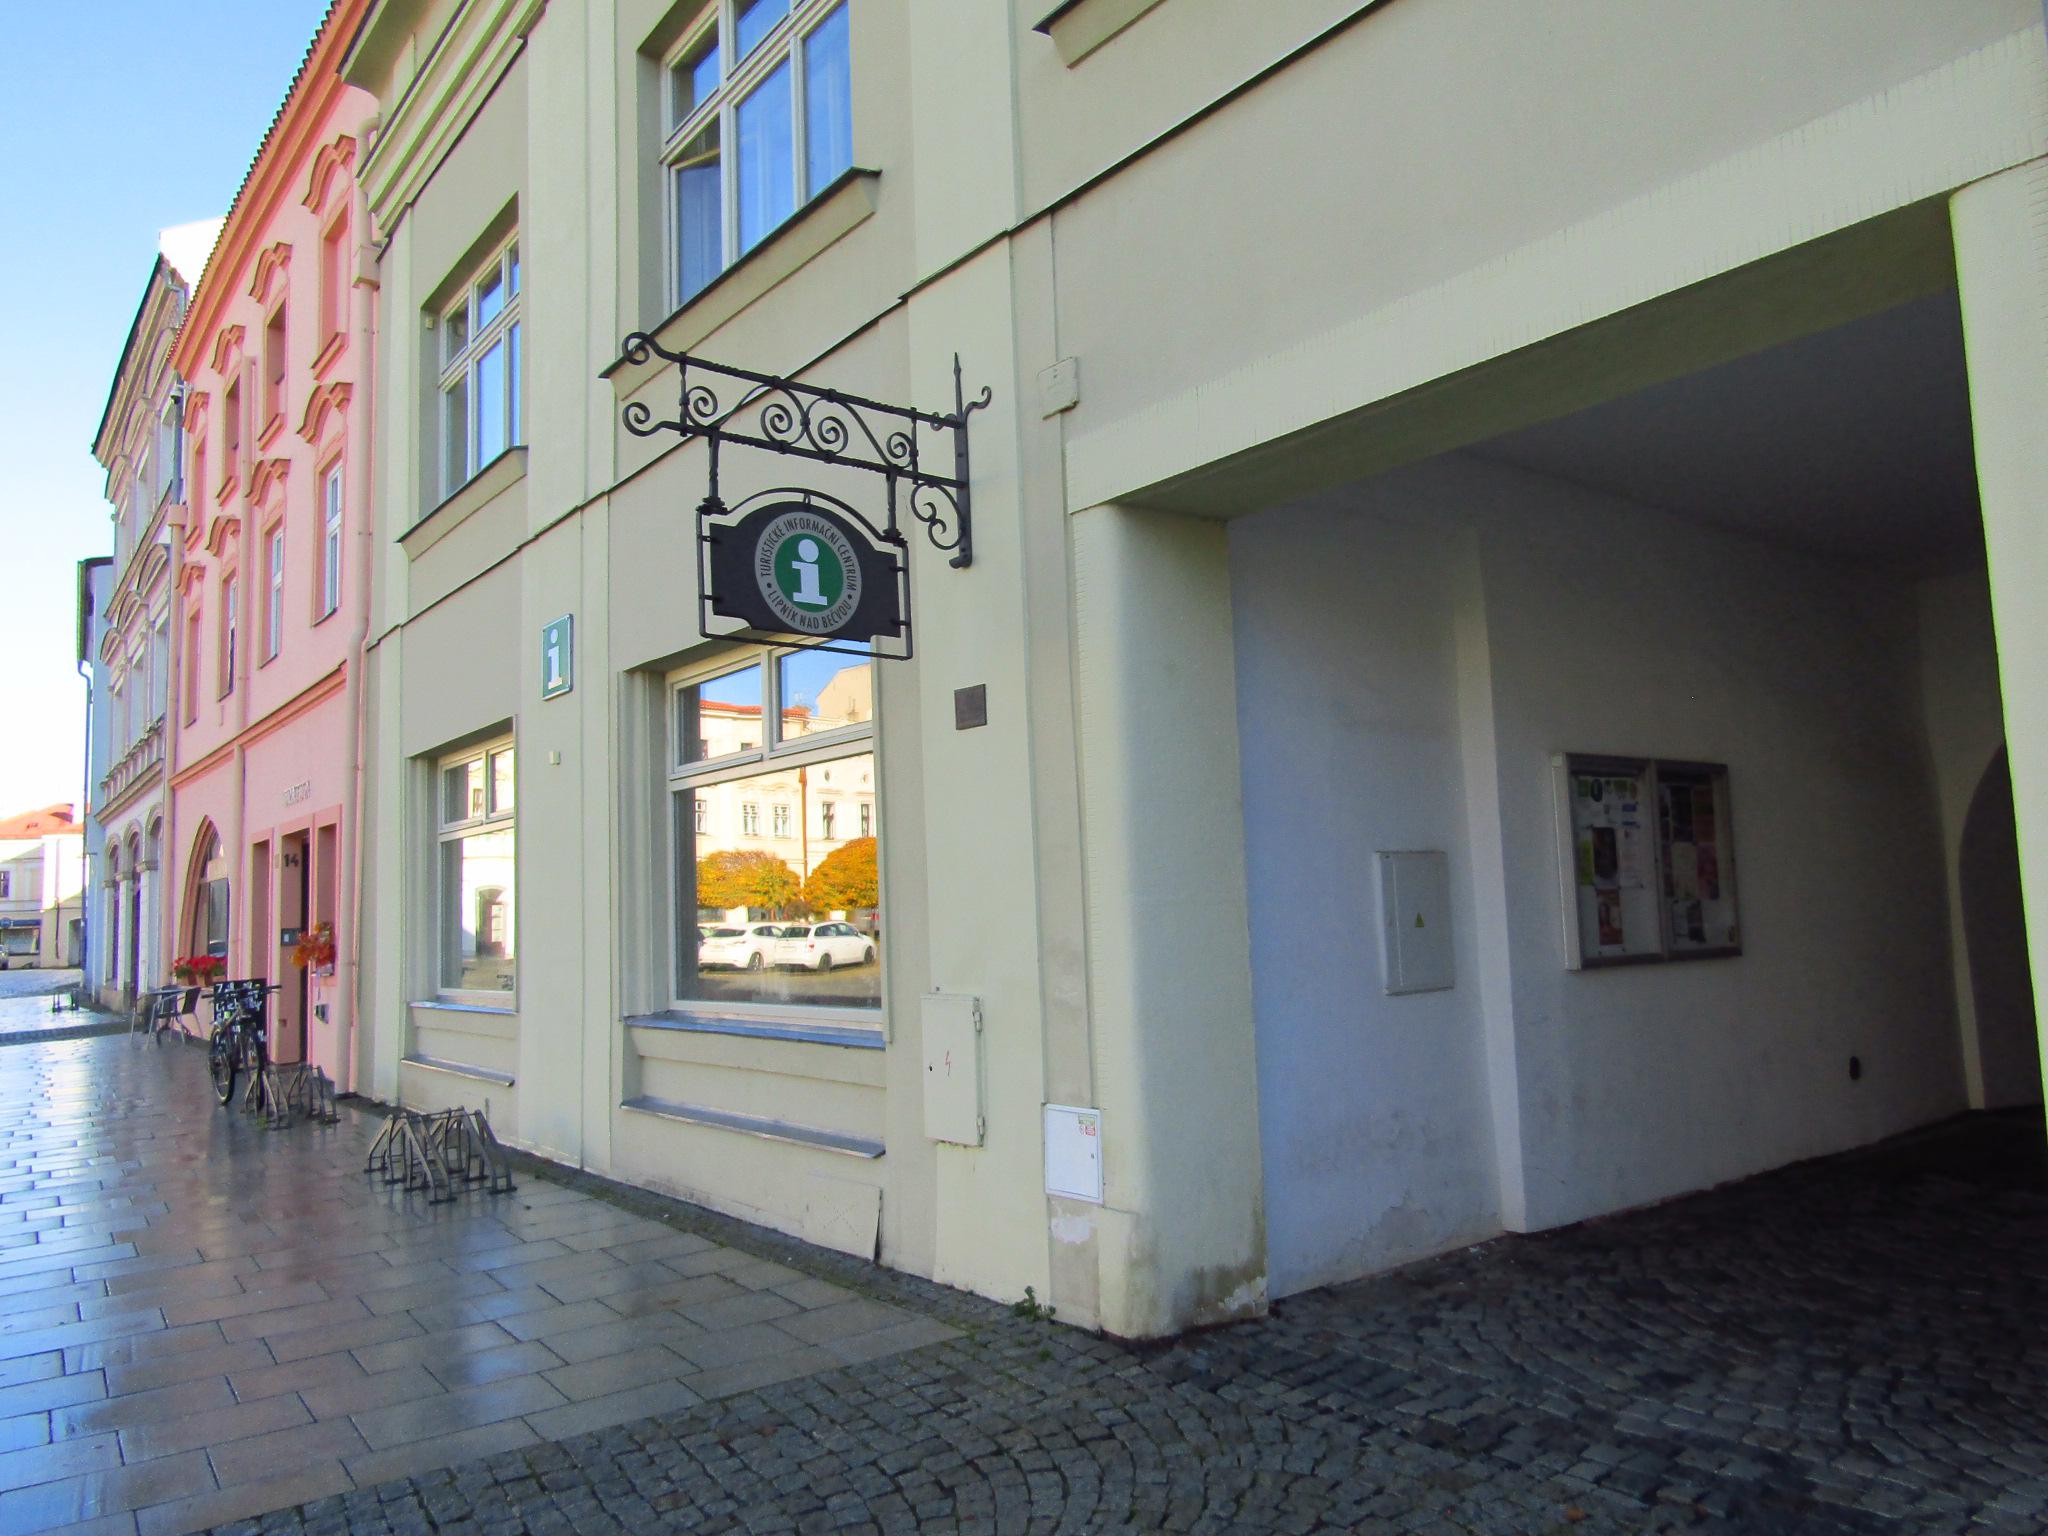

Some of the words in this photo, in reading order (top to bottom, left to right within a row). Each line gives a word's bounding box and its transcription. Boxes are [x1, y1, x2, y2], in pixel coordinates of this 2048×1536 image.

[760, 521, 786, 577] TURISTICKÉ
[783, 517, 840, 546] INFORMAČNÍ
[837, 543, 858, 592] CENTRUM
[767, 589, 799, 624] LIPNÍK
[799, 615, 820, 630] NAD
[821, 601, 853, 629] BEČVOU
[283, 853, 298, 868] 14
